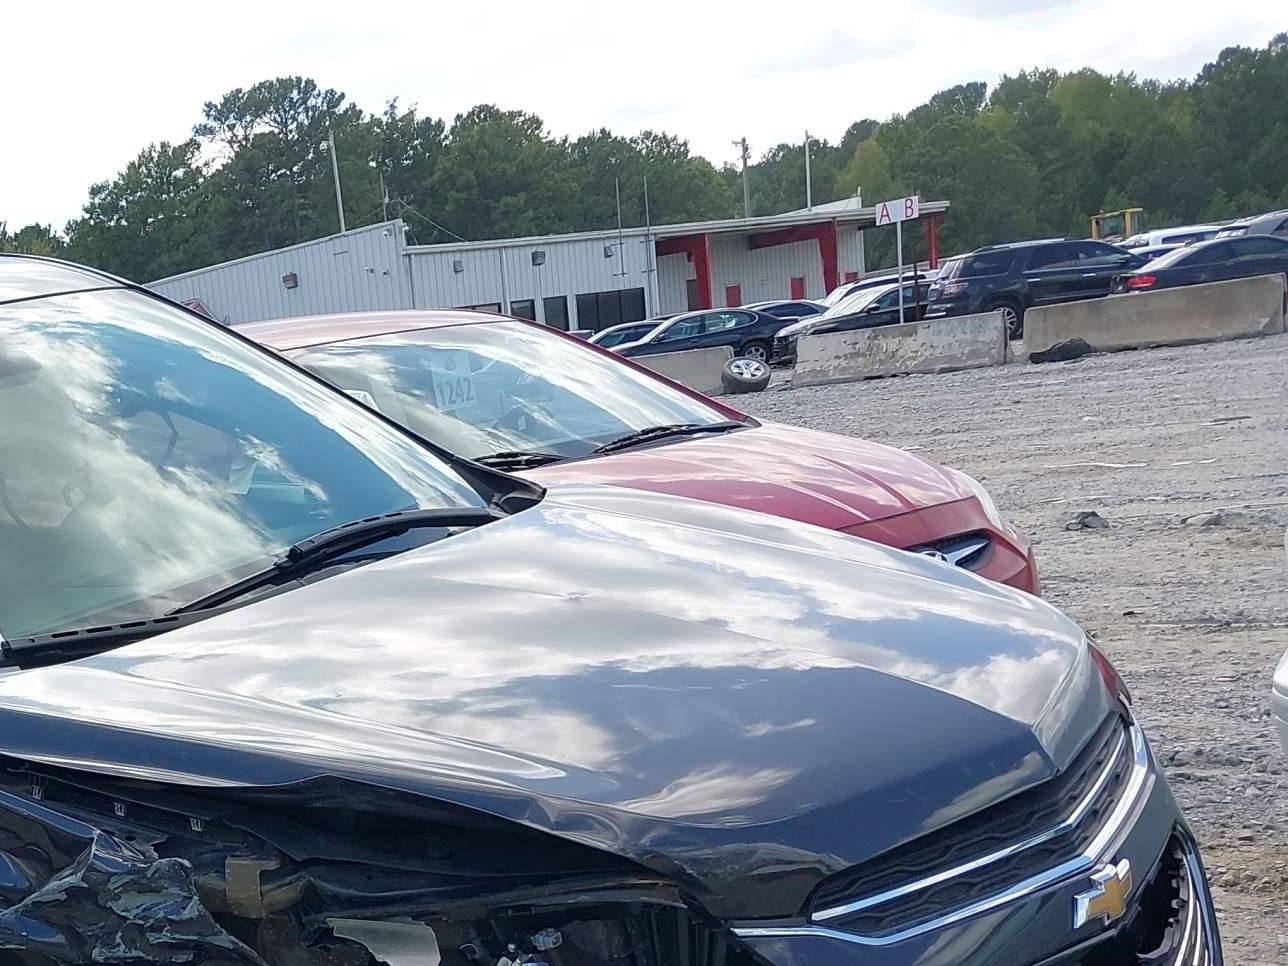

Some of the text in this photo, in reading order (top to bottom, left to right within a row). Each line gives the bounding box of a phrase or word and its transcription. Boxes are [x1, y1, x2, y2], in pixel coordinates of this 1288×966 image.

[879, 198, 914, 223] A B
[436, 376, 474, 406] 1242
